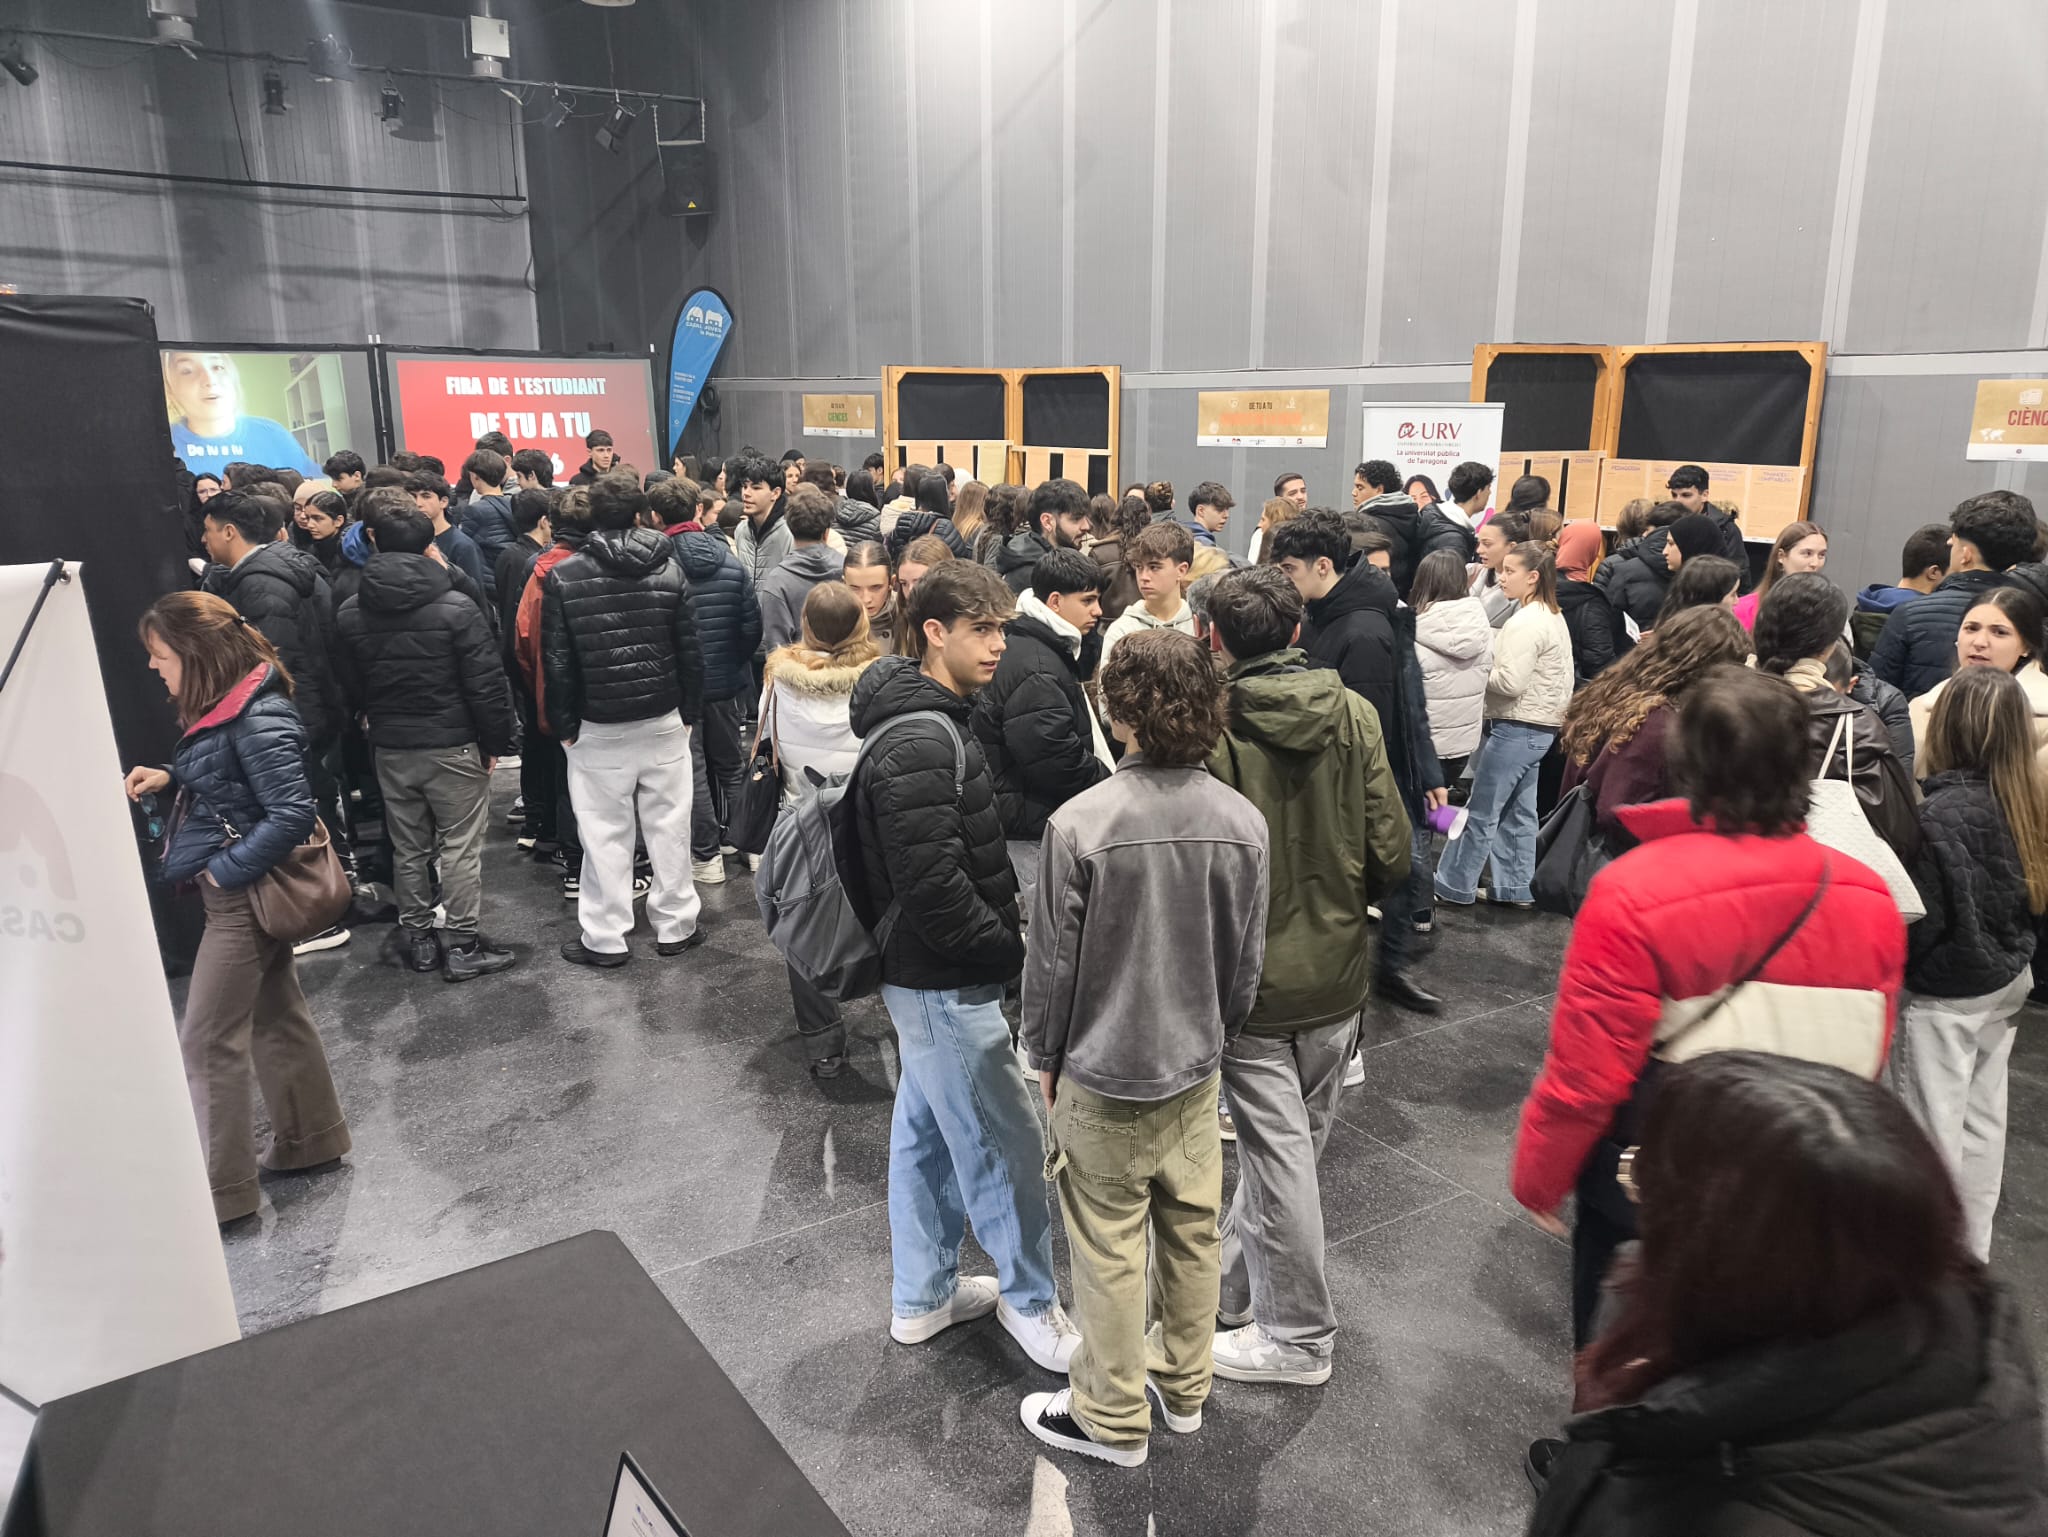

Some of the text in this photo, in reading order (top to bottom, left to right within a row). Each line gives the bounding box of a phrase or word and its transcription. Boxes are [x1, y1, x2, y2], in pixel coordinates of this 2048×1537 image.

[445, 376, 607, 395] FIRA DE L'ESTUDIANT
[469, 411, 593, 440] DE TU A TU
[1421, 422, 1463, 440] URV
[1416, 458, 1448, 466] Tarragona
